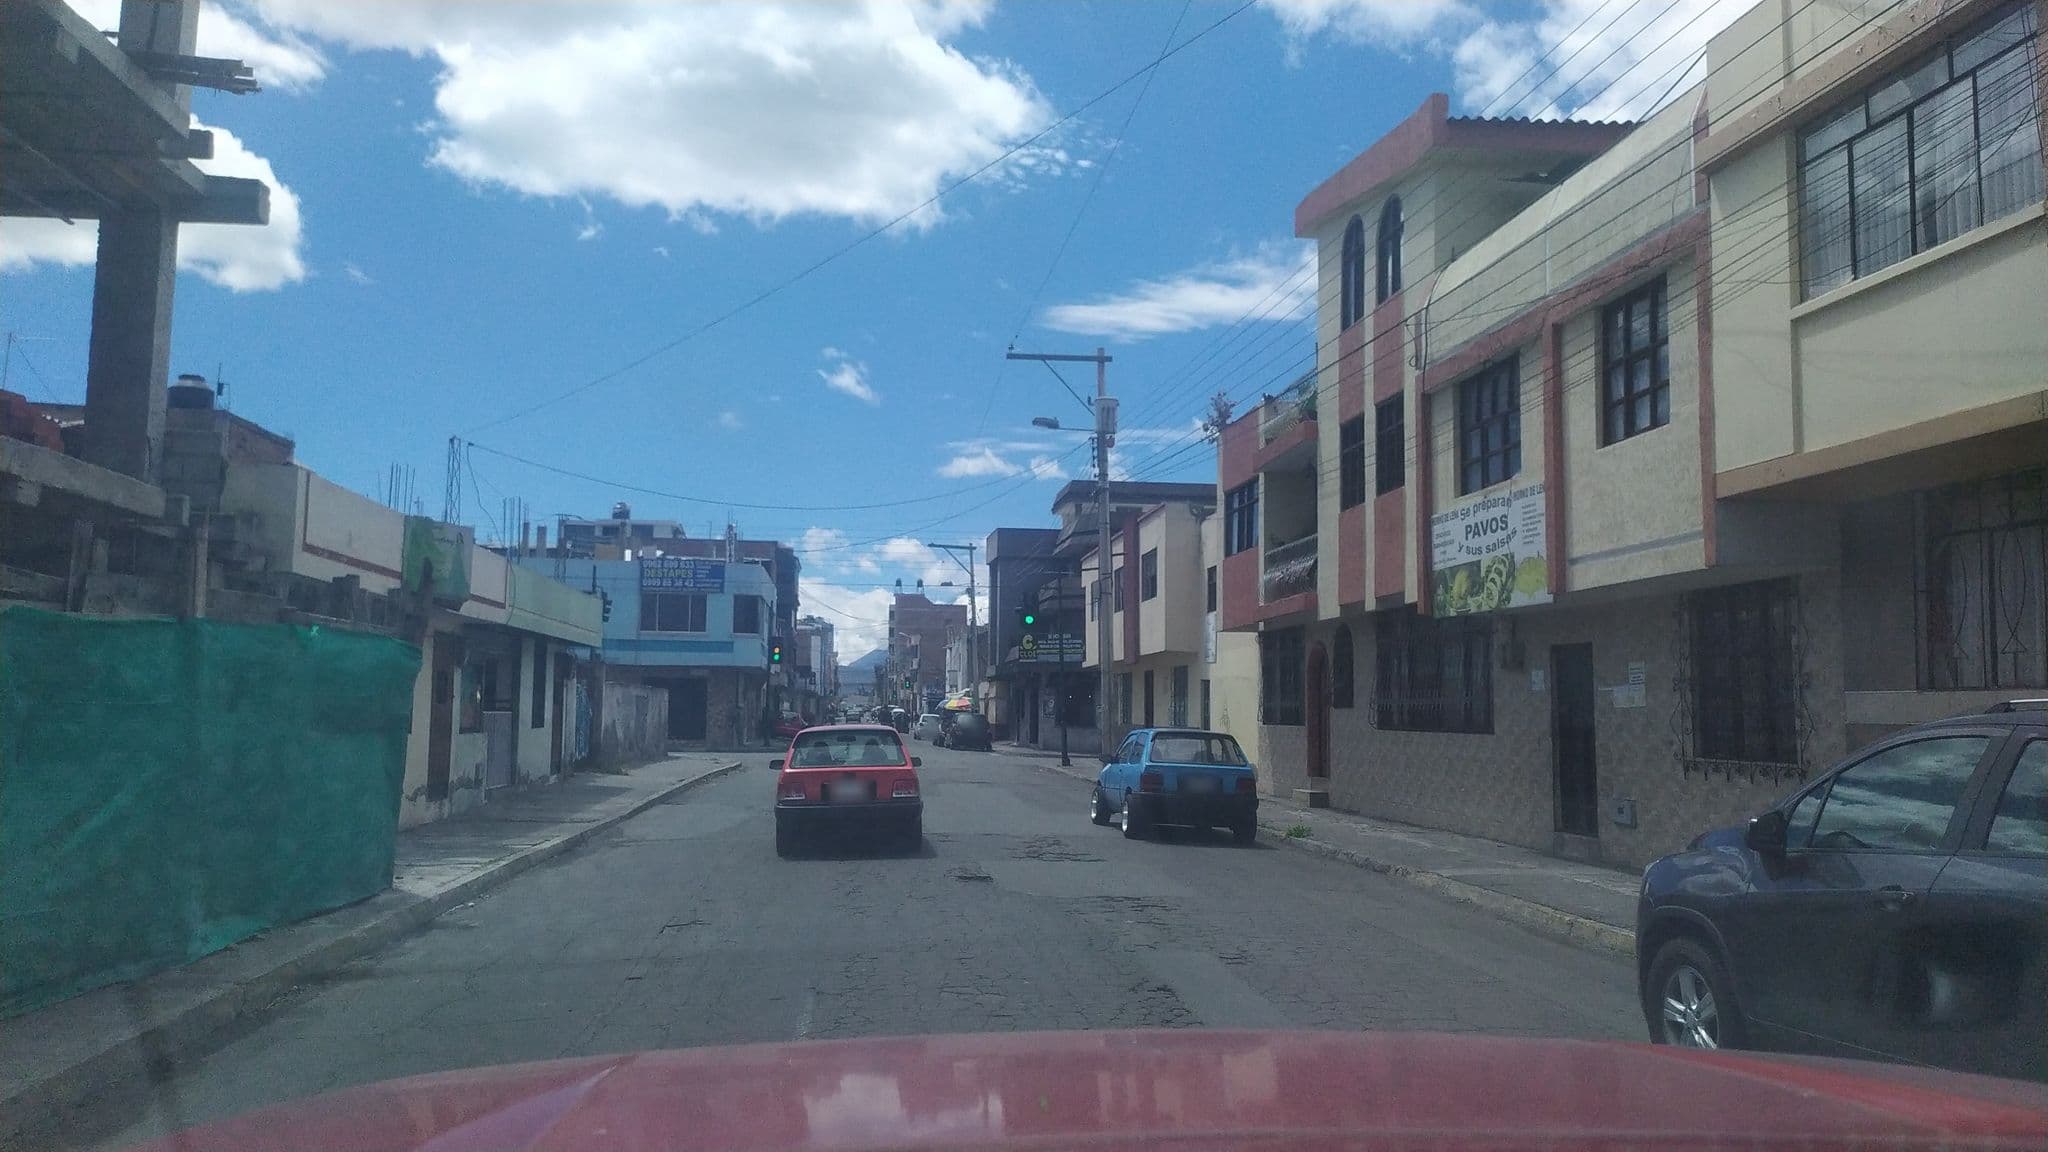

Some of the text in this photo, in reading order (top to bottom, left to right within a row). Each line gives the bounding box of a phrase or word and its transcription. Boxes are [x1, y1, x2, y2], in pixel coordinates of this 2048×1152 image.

[1472, 496, 1512, 517] preparan
[1464, 514, 1509, 541] PAVOS
[1458, 542, 1465, 553] y
[1465, 545, 1483, 556] sus
[1485, 527, 1518, 554] salsas
[643, 568, 694, 578] DESTAPES
